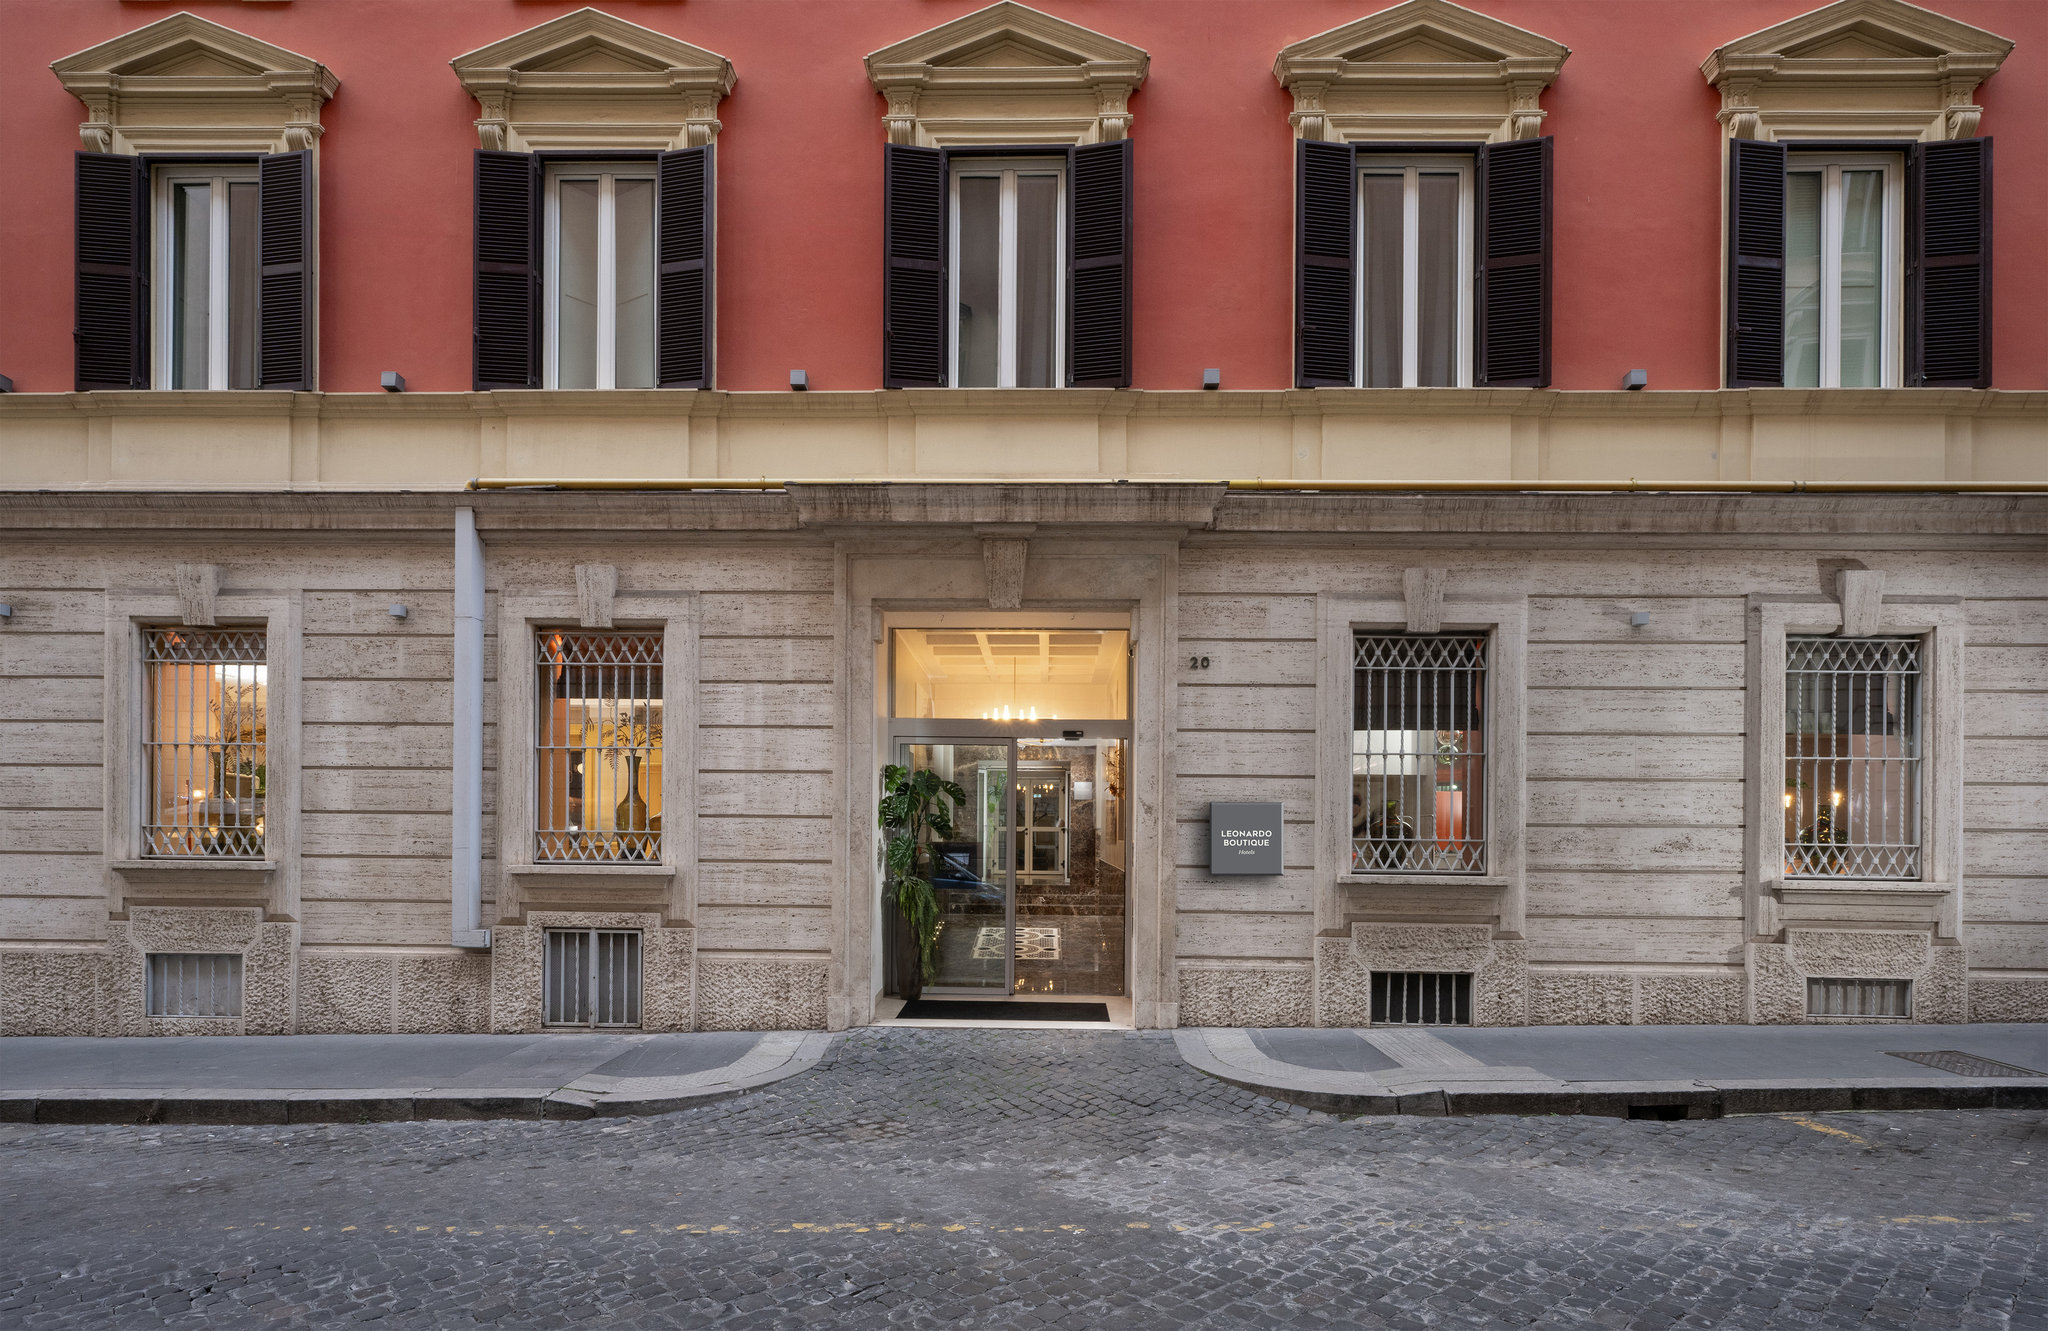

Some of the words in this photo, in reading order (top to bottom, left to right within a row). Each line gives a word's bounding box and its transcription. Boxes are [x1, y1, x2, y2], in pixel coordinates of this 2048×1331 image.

[1190, 656, 1209, 669] 20
[1221, 829, 1273, 838] LEONARDO
[1223, 839, 1270, 847] BOUTIQUE
